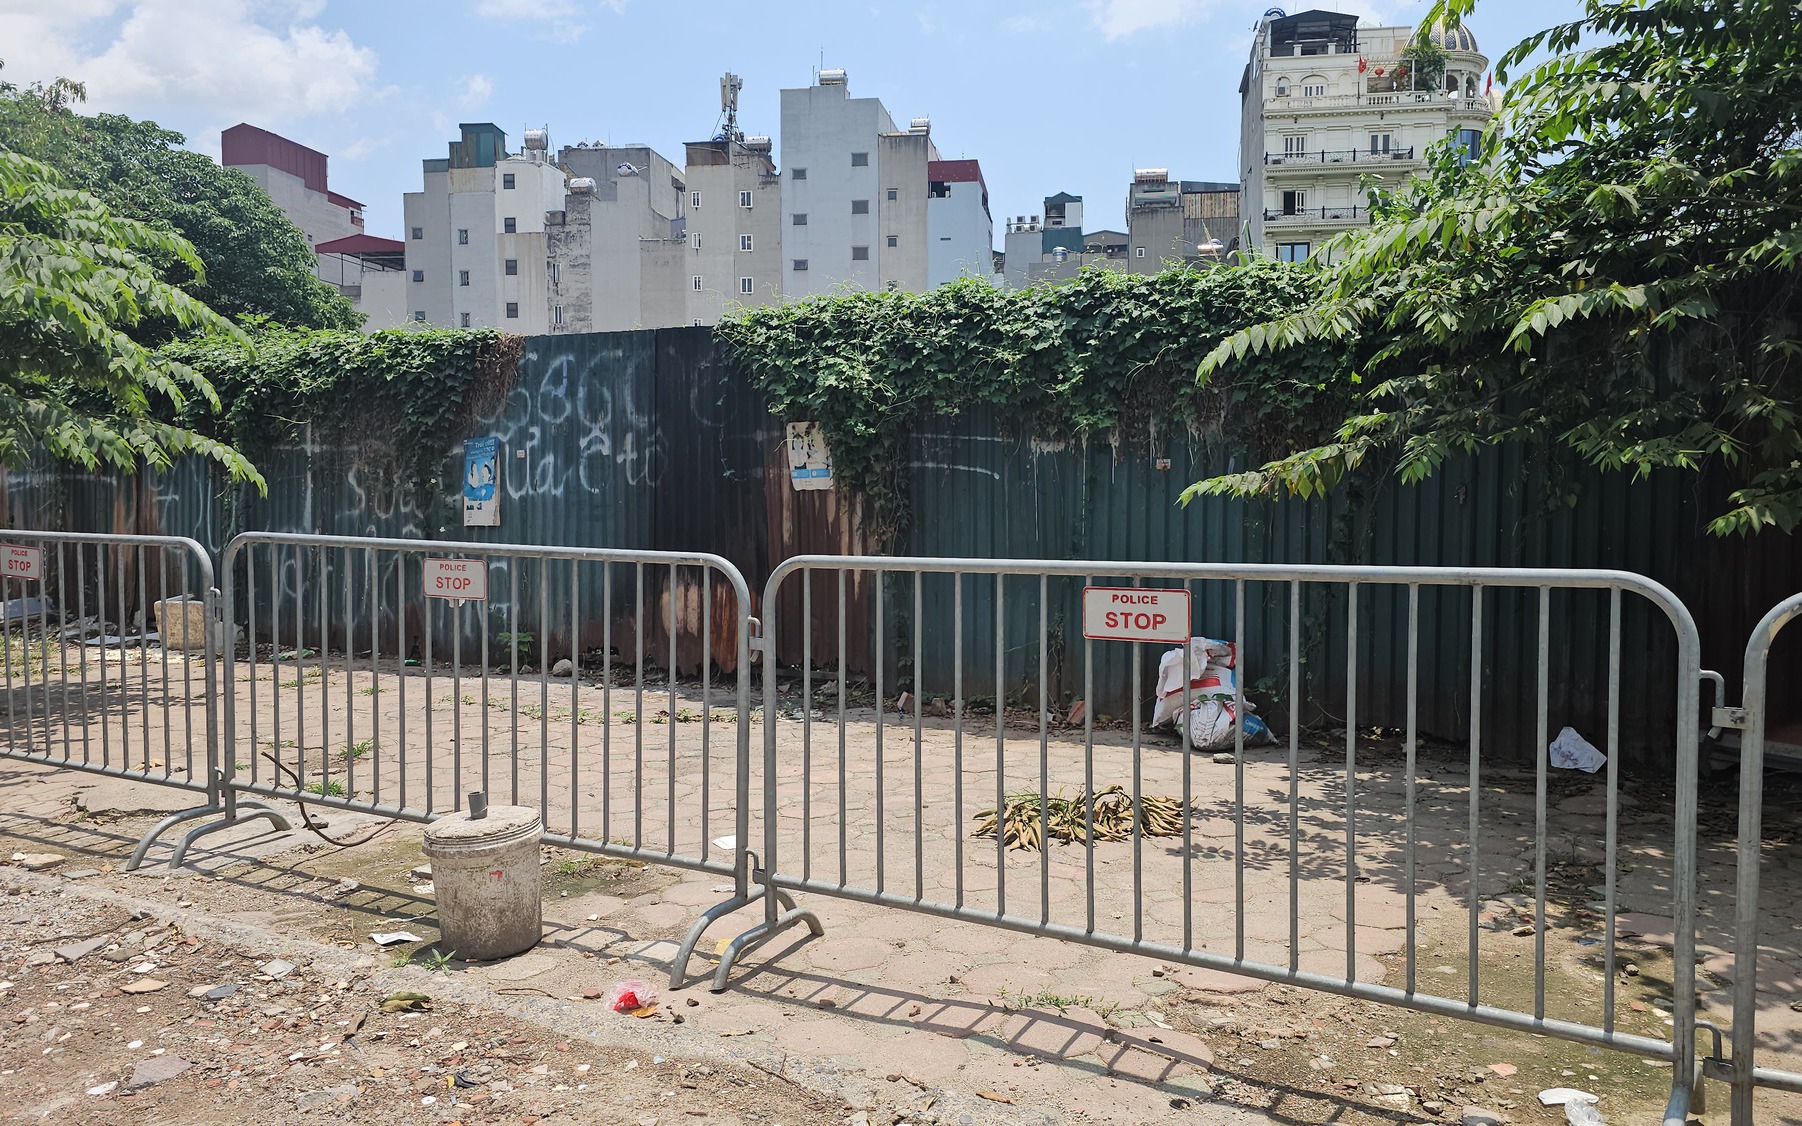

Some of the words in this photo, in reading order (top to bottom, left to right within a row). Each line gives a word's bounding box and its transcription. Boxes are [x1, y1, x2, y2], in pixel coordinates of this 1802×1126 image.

[11, 549, 28, 557] POLICE
[8, 559, 31, 572] STOP
[439, 563, 467, 571] POLICE
[436, 576, 471, 590] STOP
[1112, 594, 1158, 605] POLICE
[1105, 611, 1167, 630] STOP
